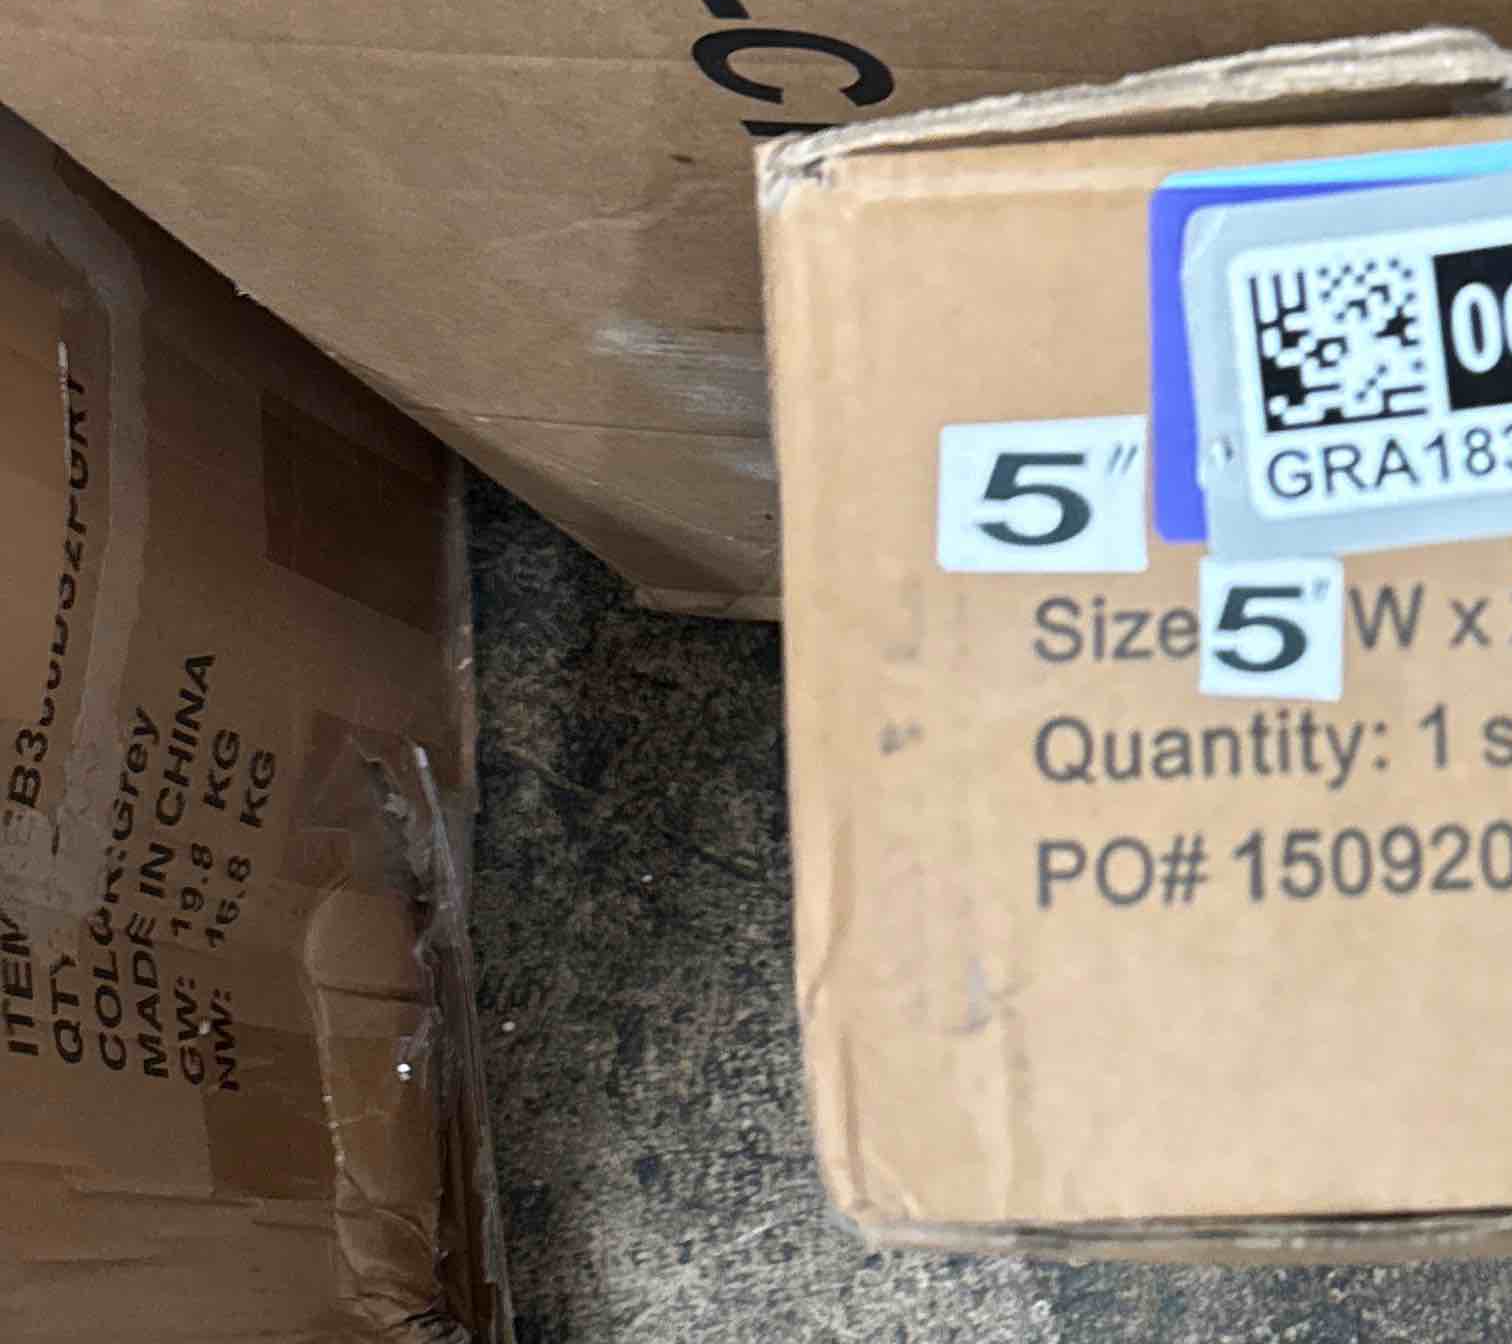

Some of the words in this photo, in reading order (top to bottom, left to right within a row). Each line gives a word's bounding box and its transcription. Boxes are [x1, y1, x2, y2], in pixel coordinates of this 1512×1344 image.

[1449, 597, 1492, 648] x
[155, 654, 215, 826] CHINA
[203, 728, 241, 811] KG
[1033, 706, 1388, 791] Quantity:
[1419, 703, 1450, 770] 1
[239, 750, 277, 829] KG
[139, 842, 176, 899] IN
[1036, 834, 1210, 910] PO#
[127, 911, 169, 1079] MADE
